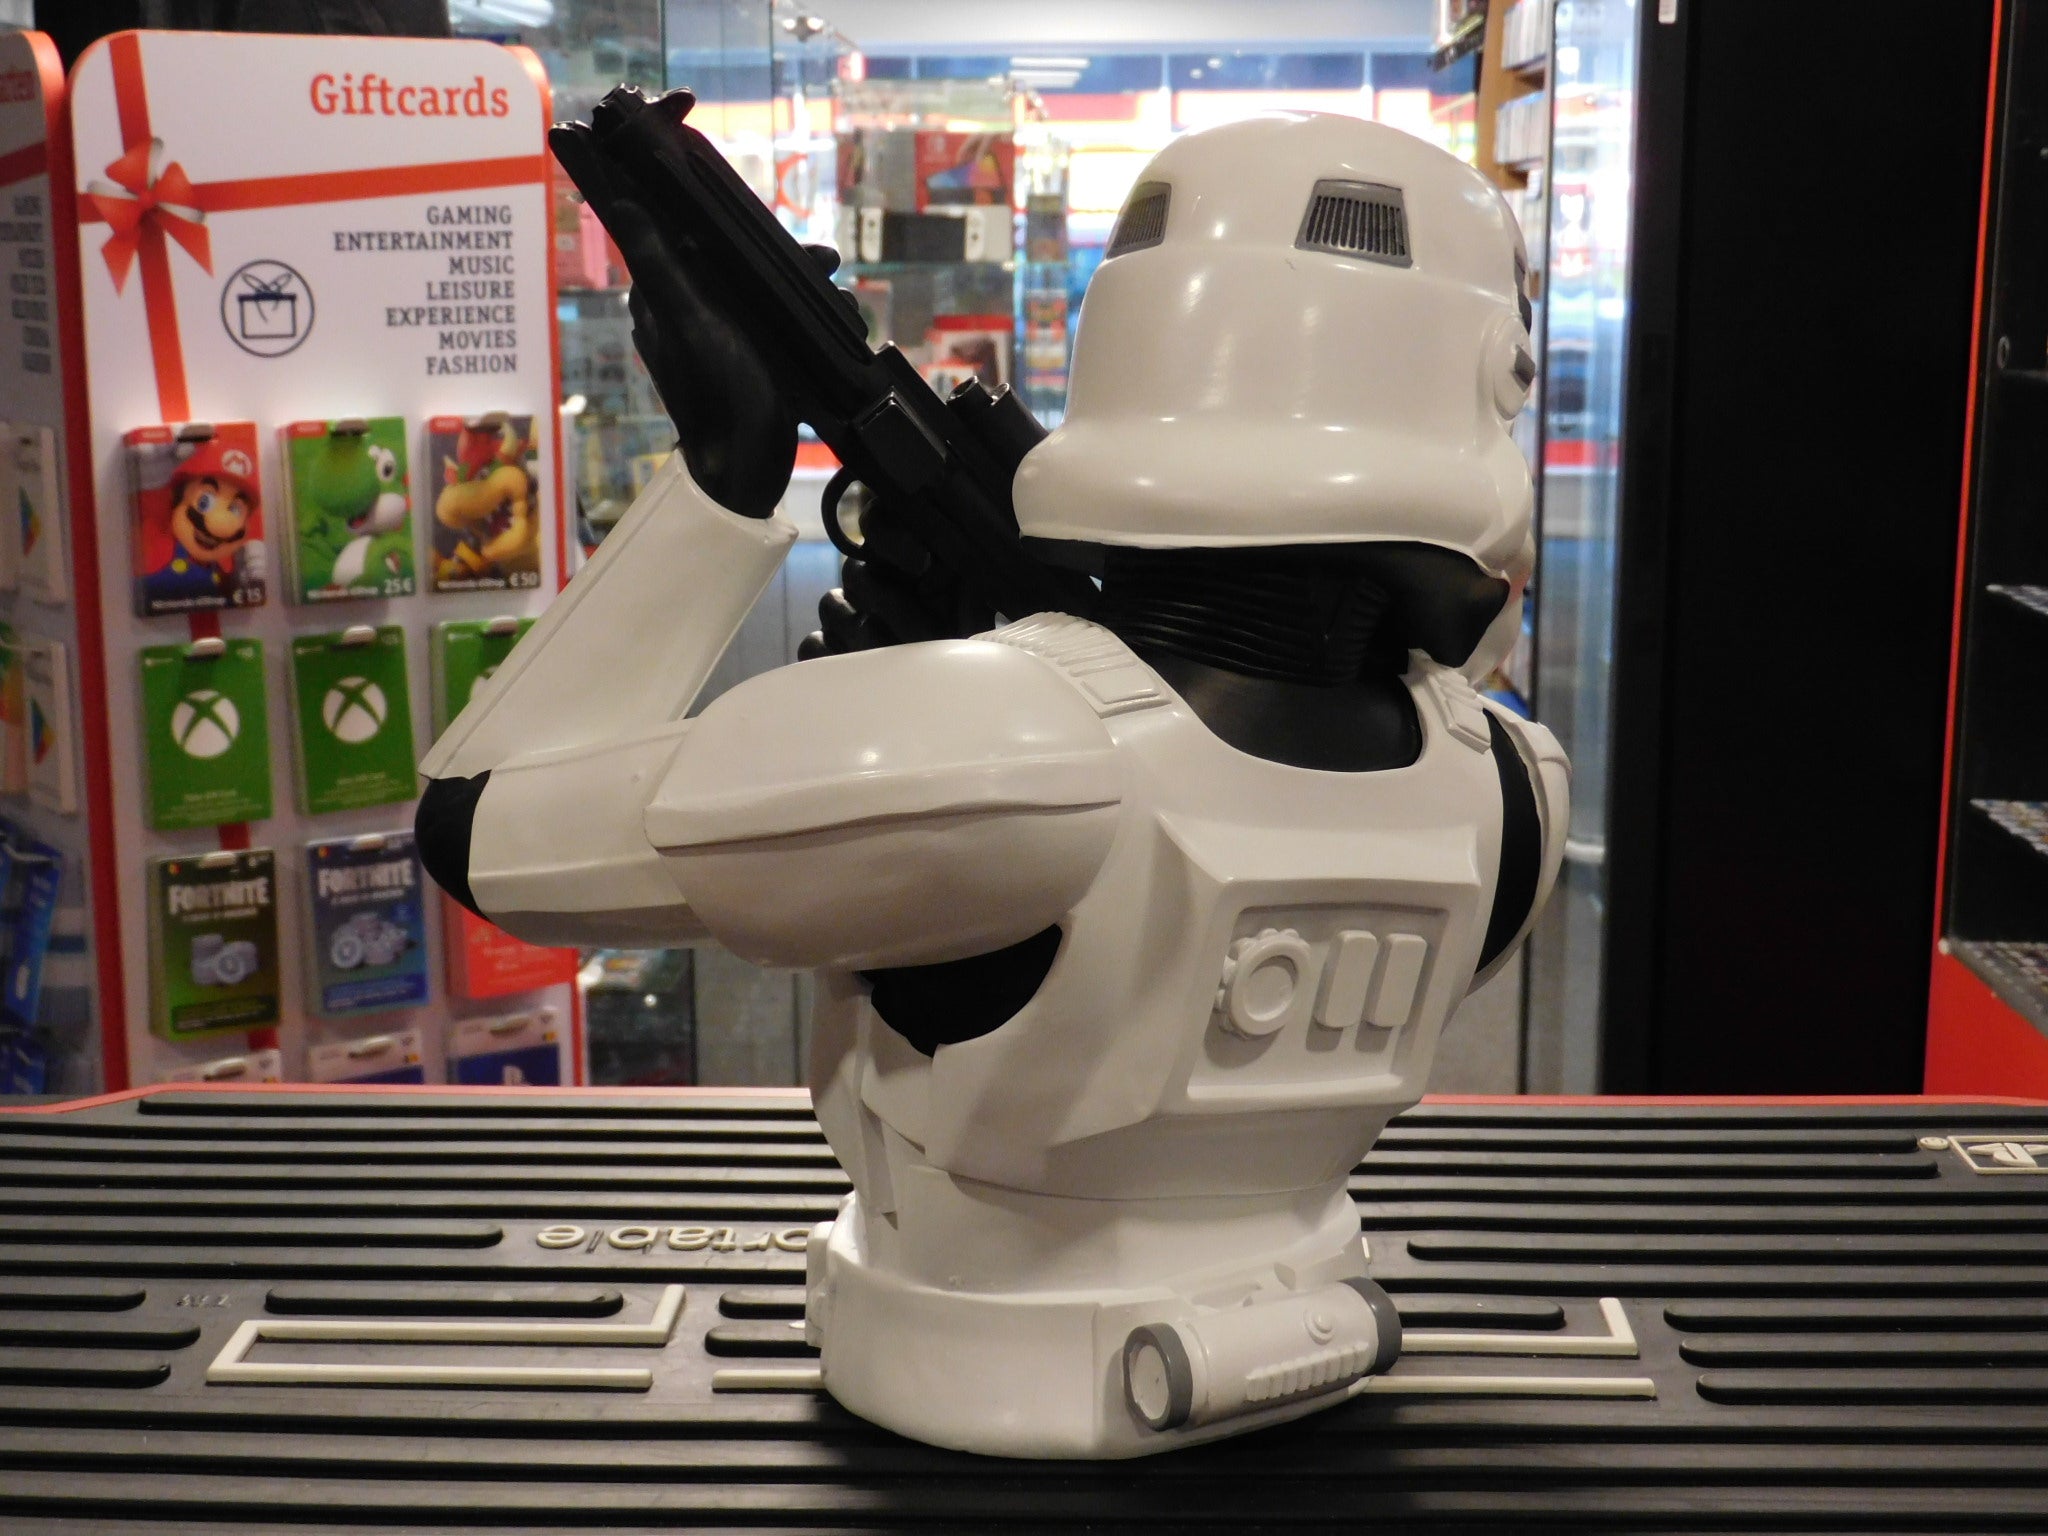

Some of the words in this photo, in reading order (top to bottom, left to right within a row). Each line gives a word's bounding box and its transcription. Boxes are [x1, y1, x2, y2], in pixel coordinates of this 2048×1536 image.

[309, 73, 510, 118] Giftcards
[426, 205, 512, 226] GAMING
[333, 231, 513, 251] ENTERTAINMENT
[449, 256, 515, 275] MUSIC
[426, 281, 515, 300] LEISURE
[385, 305, 516, 327] EXPERIENCE
[438, 330, 516, 350] MOVIES
[425, 355, 517, 376] FASHION
[536, 1224, 808, 1253] ortable
